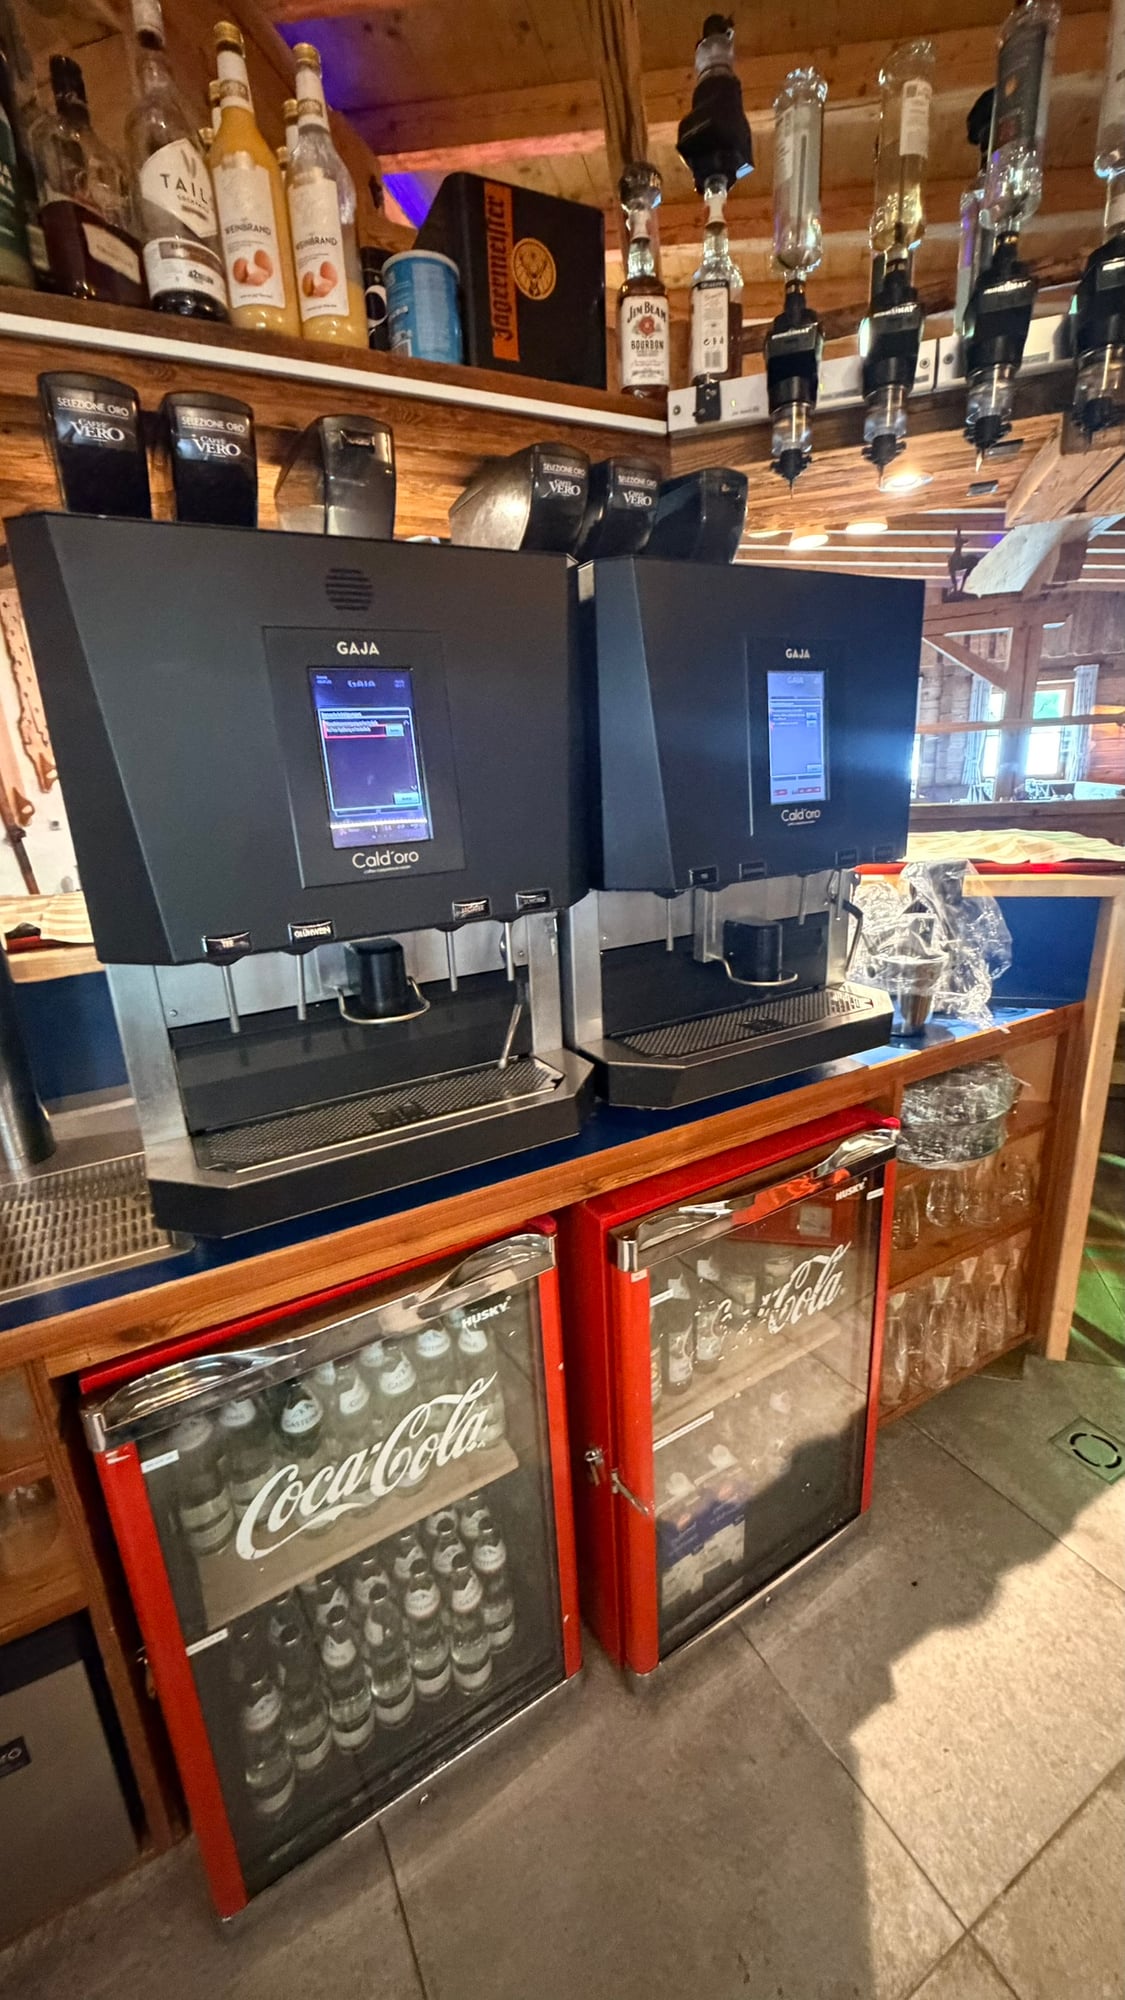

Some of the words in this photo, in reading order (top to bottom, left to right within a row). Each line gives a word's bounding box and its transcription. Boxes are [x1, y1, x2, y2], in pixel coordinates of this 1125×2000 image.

[627, 302, 643, 324] JIM
[644, 301, 666, 323] BEAM
[631, 340, 664, 350] BOURBON
[57, 396, 106, 413] SELEZIONE
[107, 404, 129, 417] ORO
[70, 420, 125, 442] VERO
[182, 415, 225, 429] SELEZIONE
[226, 421, 245, 433] ORO
[192, 438, 242, 457] VERO
[549, 481, 581, 496] VERO
[623, 492, 652, 506] VERO
[336, 641, 380, 656] GAJA
[785, 648, 811, 659] GAJA
[835, 1181, 866, 1201] HUSKY
[461, 1302, 509, 1328] HUSKY
[235, 1371, 498, 1561] Coca-Cola
